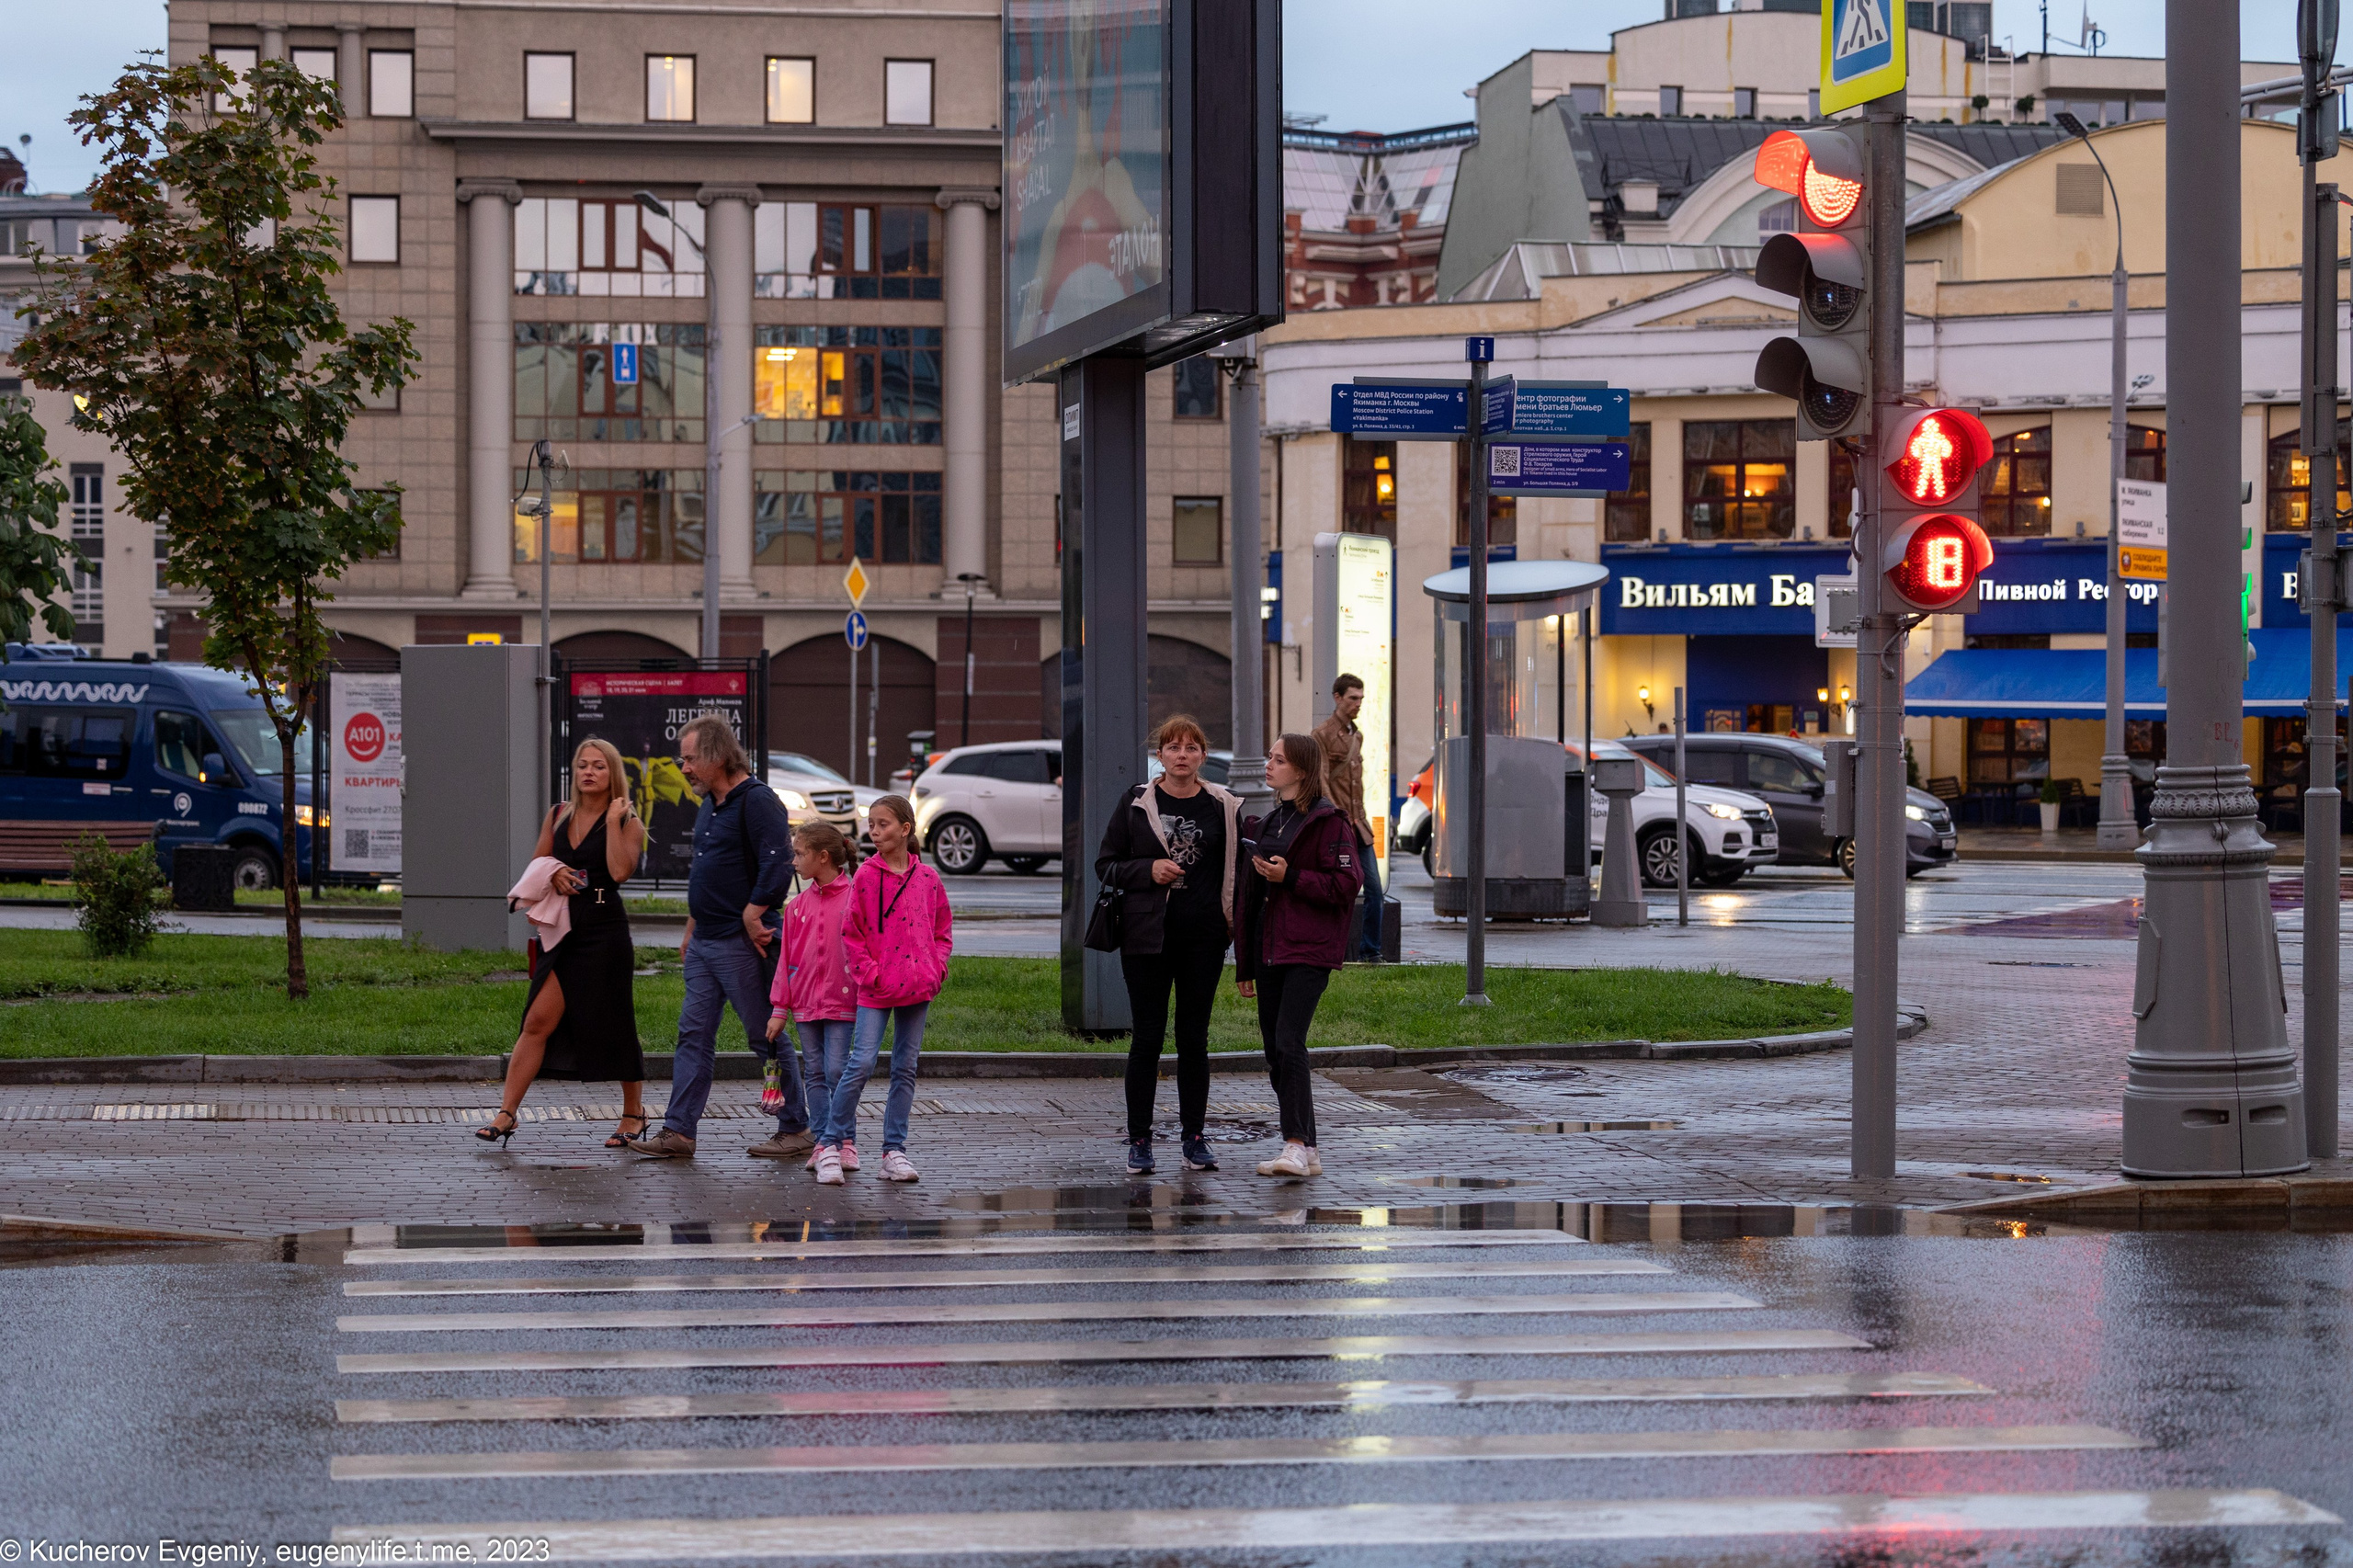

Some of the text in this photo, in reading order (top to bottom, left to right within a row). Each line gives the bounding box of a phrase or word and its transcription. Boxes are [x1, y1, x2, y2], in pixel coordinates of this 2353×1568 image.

[1017, 112, 1055, 168] КВАРТАЛ
[1017, 163, 1051, 212] SHAGAL
[1353, 391, 1373, 399] Отдел
[1537, 394, 1586, 403] фотографии
[1538, 403, 1569, 412] братьев
[1570, 404, 1603, 413] Люмьер
[1620, 576, 1757, 608] Вильям
[1978, 579, 2066, 601] Пивной
[2077, 579, 2159, 605] Реор
